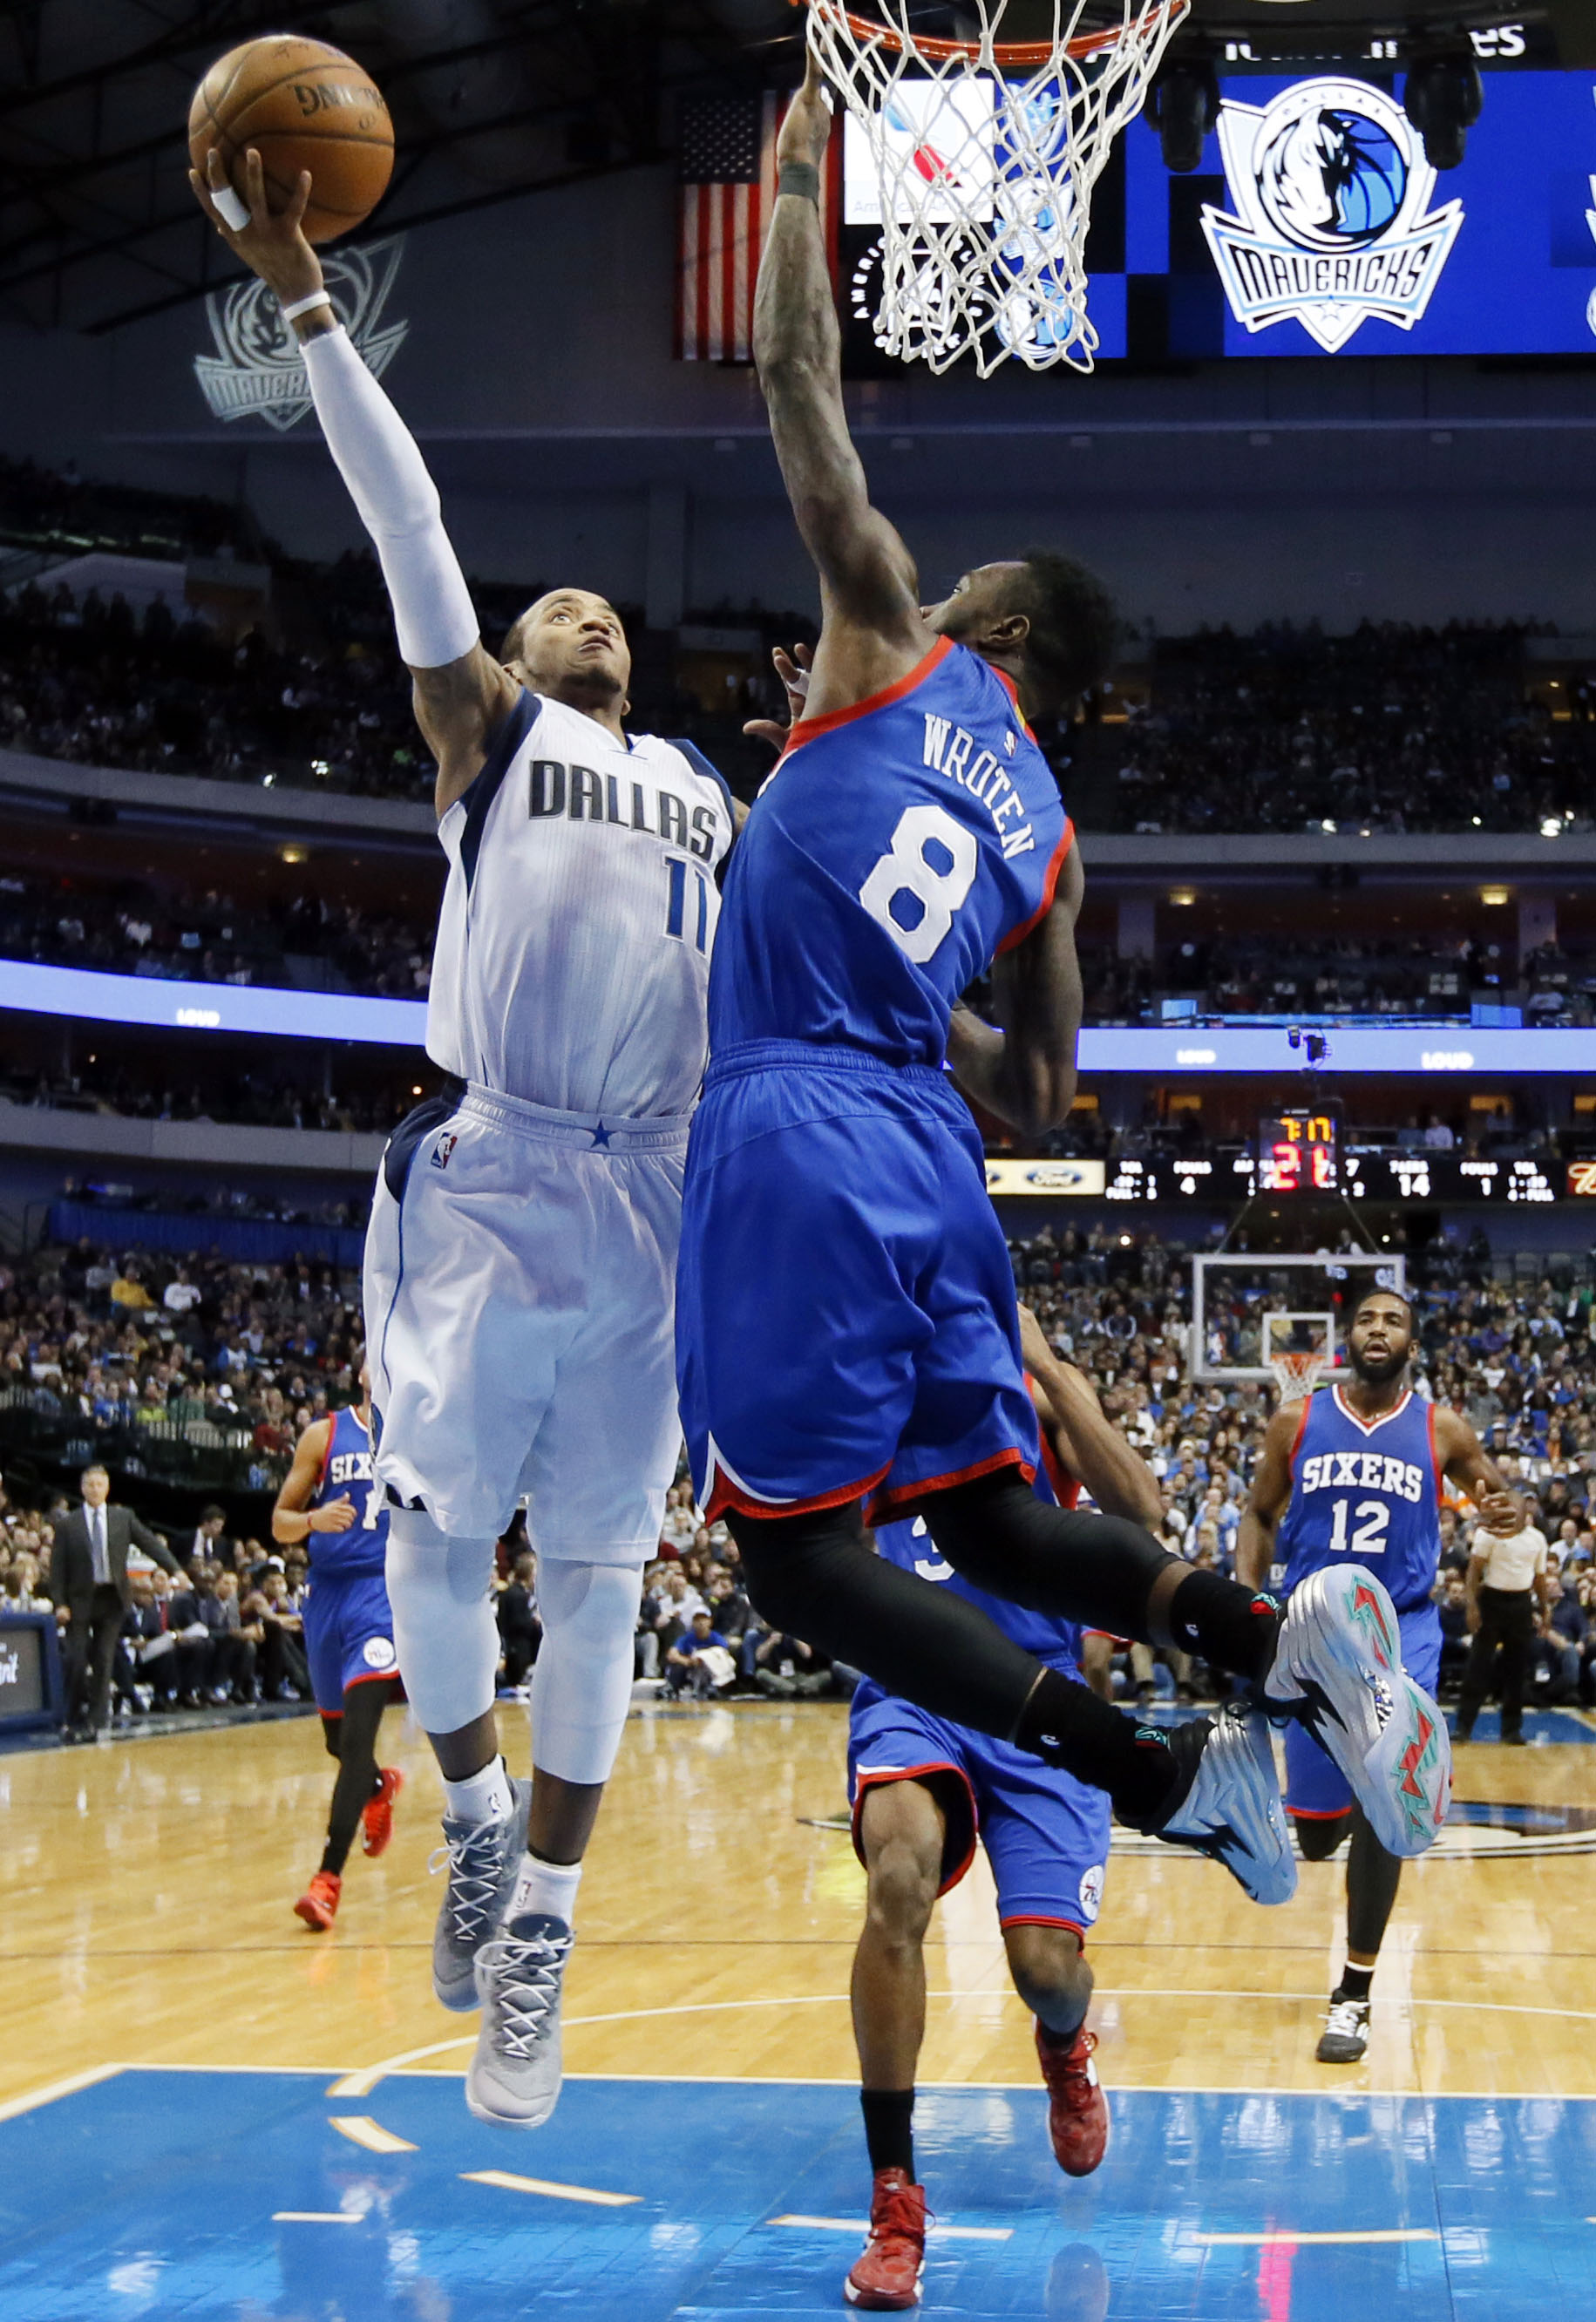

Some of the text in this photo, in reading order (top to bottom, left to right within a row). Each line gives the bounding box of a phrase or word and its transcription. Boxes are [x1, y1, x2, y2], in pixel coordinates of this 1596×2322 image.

[1281, 92, 1382, 115] DALLAS
[1228, 241, 1436, 303] MAVERICKS
[528, 759, 718, 865] DALLAS
[922, 712, 1035, 860] WROTEN
[662, 854, 709, 956] 11
[859, 805, 977, 964] 8
[1301, 1451, 1423, 1504] SIXERS
[1329, 1498, 1390, 1553] 12
